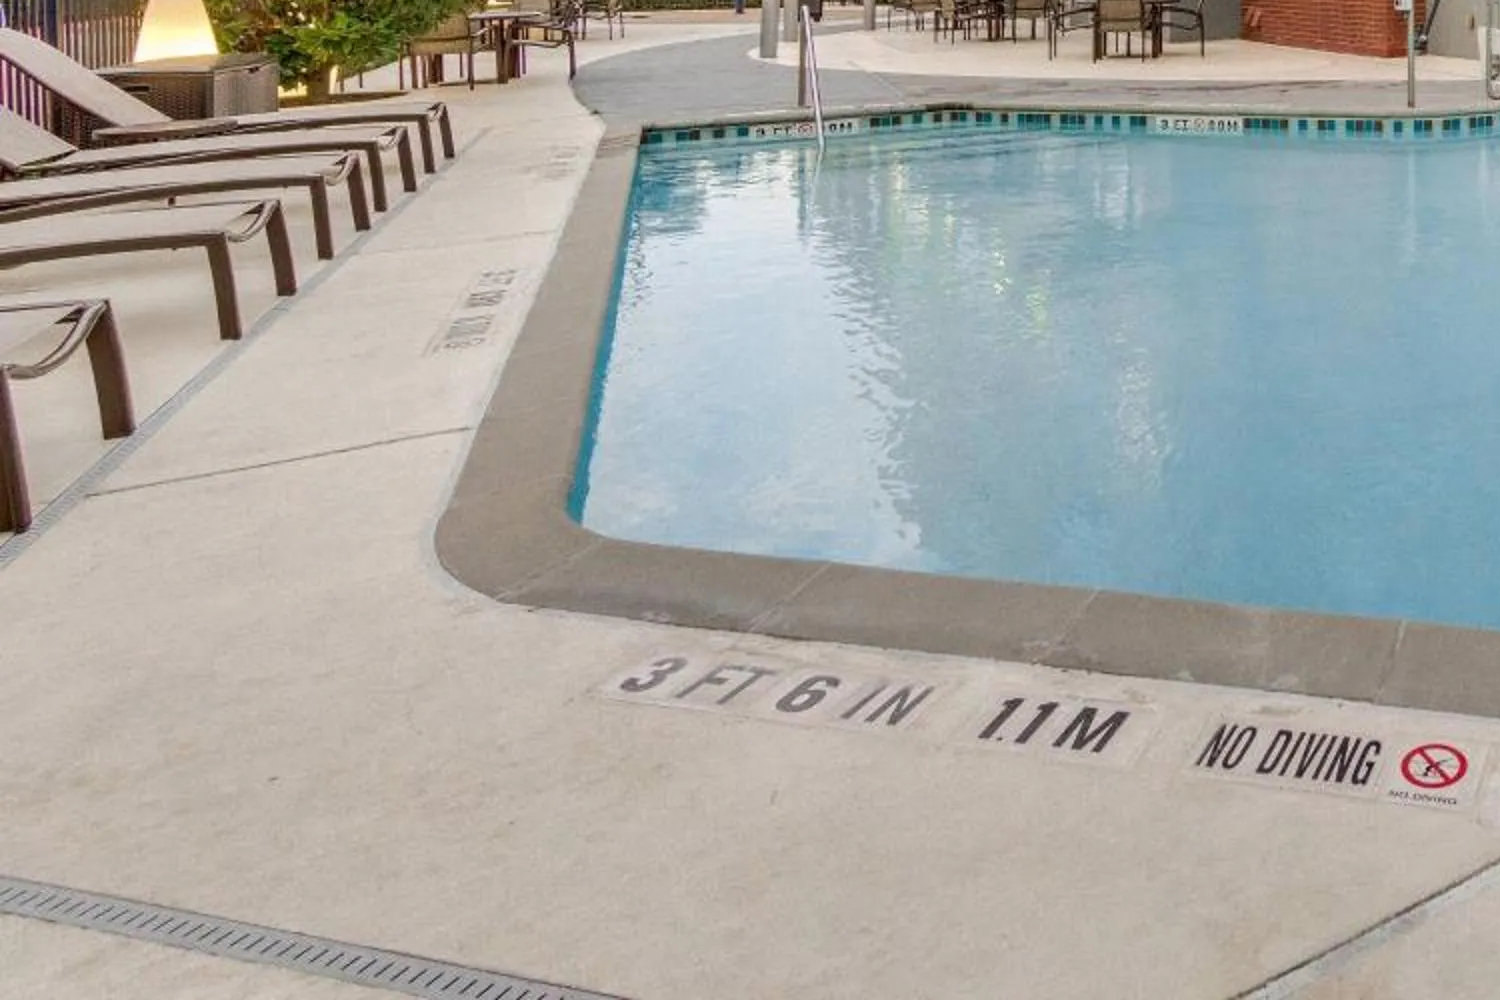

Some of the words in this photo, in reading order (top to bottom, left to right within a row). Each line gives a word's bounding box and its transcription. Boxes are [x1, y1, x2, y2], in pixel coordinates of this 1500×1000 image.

[620, 657, 688, 692] 3
[675, 664, 779, 705] FT
[775, 675, 840, 713] 6
[840, 684, 935, 726] IN
[1195, 723, 1258, 769] NO
[1255, 729, 1382, 786] DIVING
